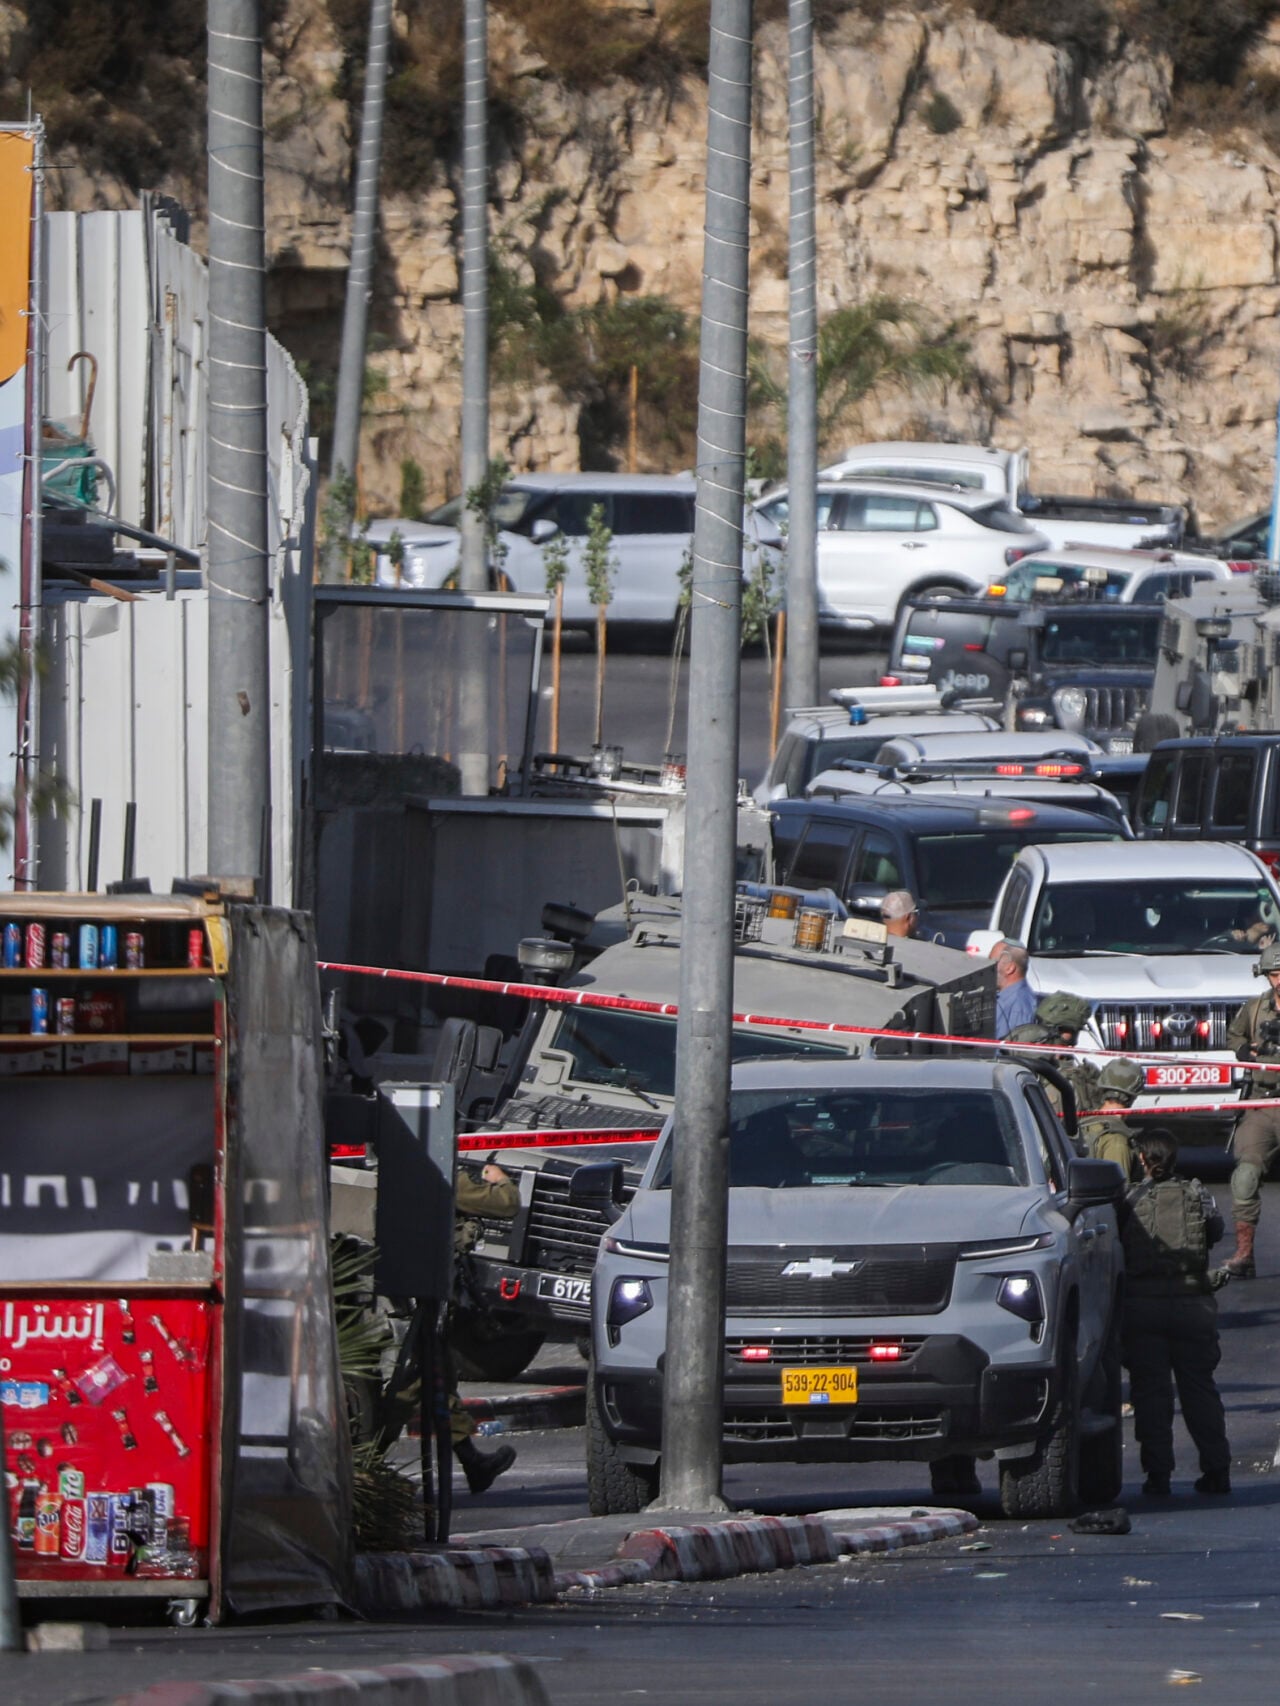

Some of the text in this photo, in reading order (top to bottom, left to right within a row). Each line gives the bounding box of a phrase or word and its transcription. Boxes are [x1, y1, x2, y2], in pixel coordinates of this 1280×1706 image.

[942, 669, 990, 693] Jeep
[1156, 1066, 1220, 1084] 300-208
[786, 1373, 855, 1392] 539-22-904
